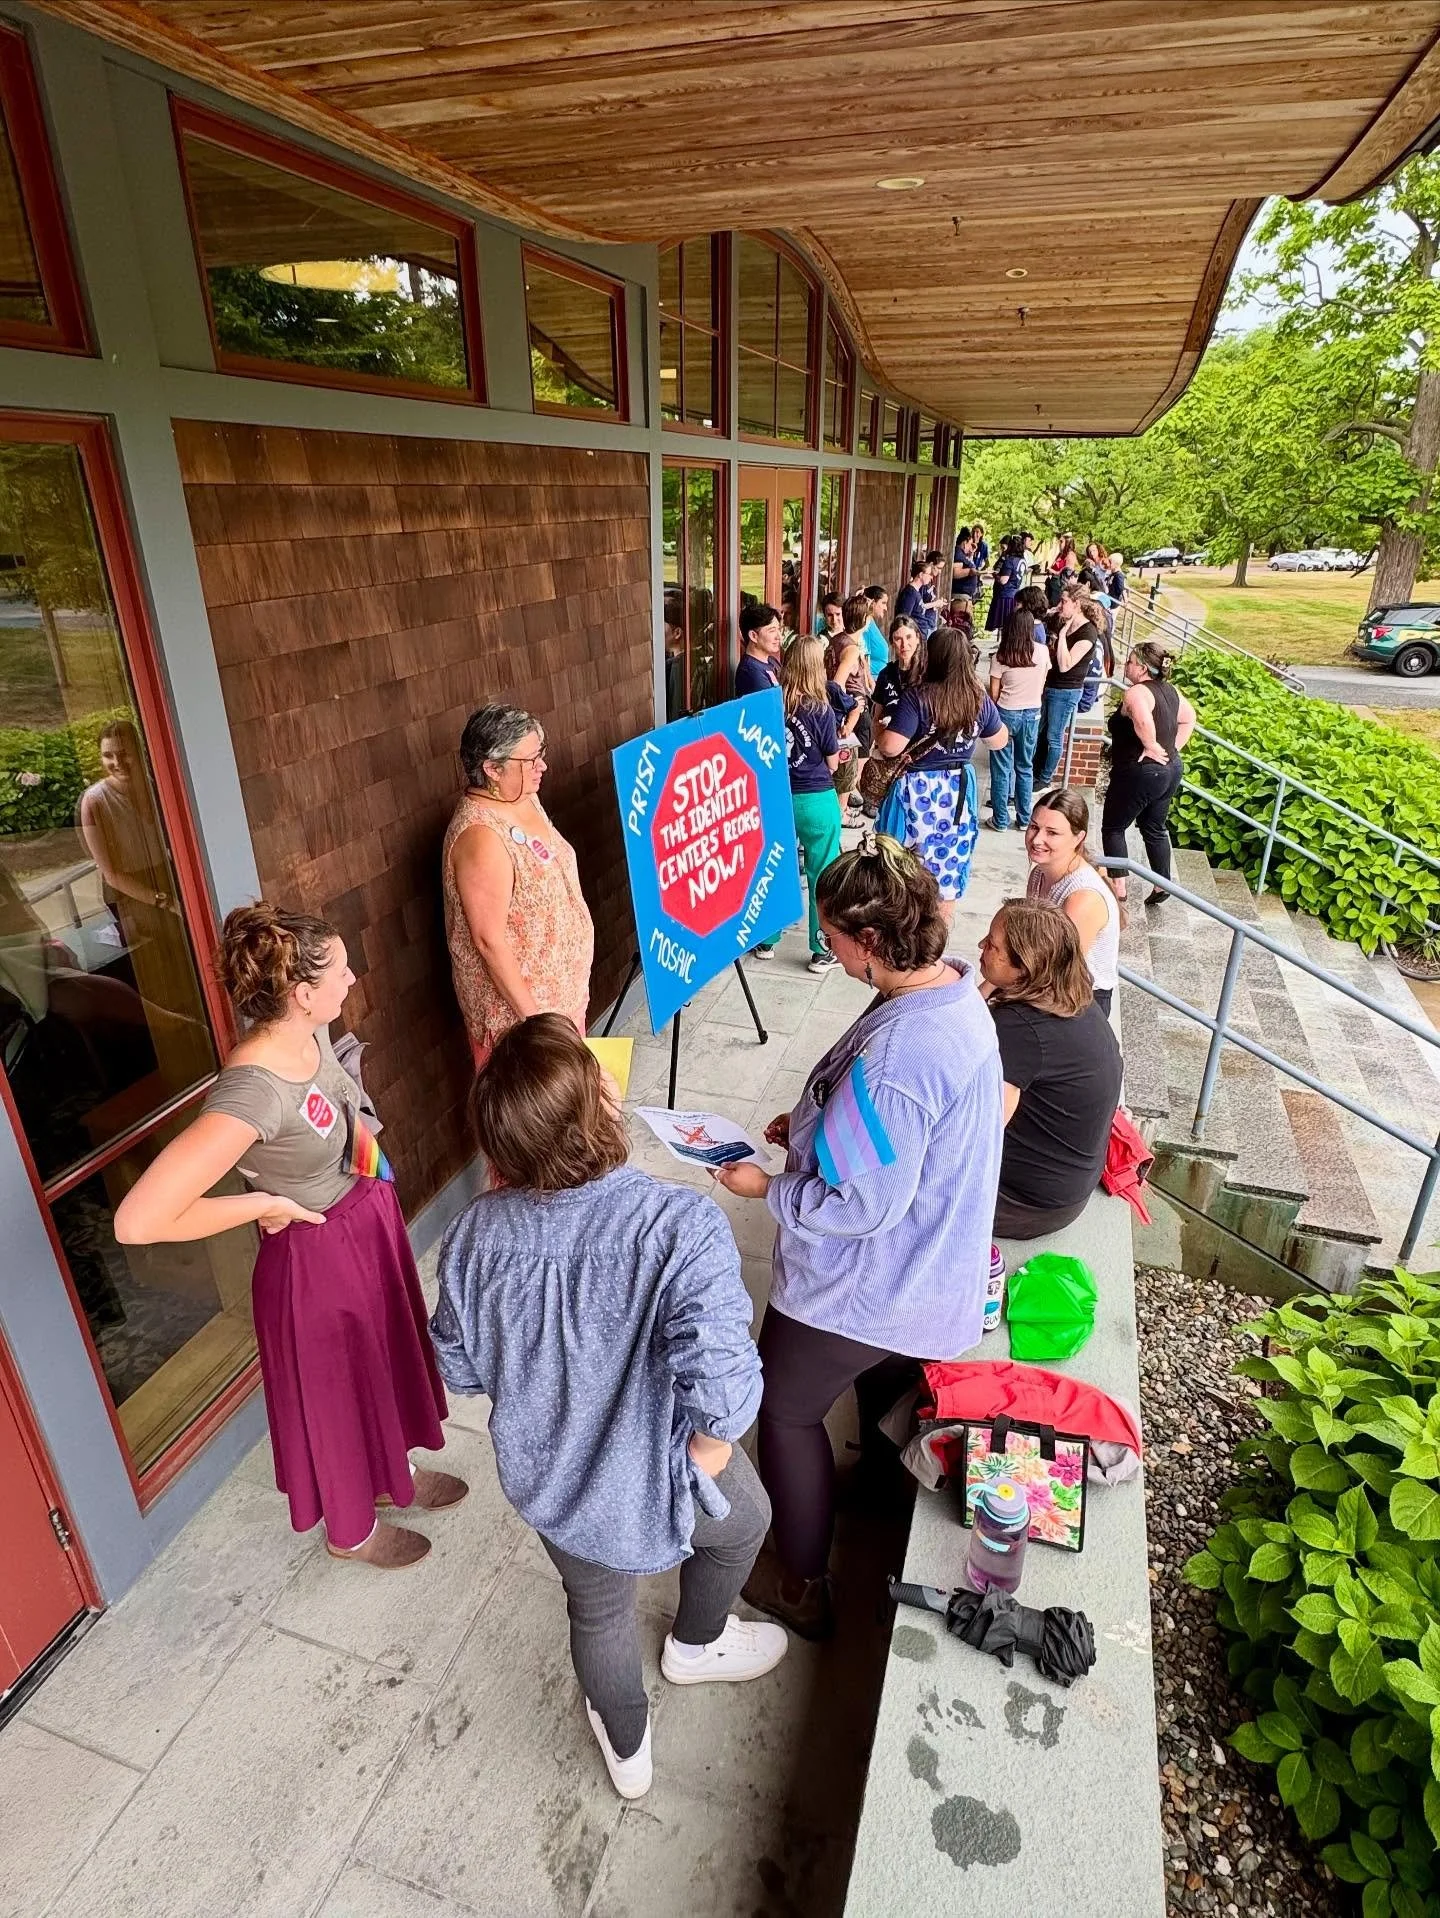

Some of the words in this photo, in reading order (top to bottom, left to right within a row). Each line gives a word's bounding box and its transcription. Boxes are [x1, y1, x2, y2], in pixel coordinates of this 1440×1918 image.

[737, 708, 781, 769] WAGE
[628, 739, 661, 836] PRISM
[659, 815, 688, 850] THE
[688, 773, 748, 835] IDENTITY
[672, 753, 727, 814] STOP
[723, 805, 760, 846] REORG
[688, 843, 745, 909] NOW!
[735, 841, 785, 949] INTERFAITH
[650, 927, 697, 984] MOSAIC
